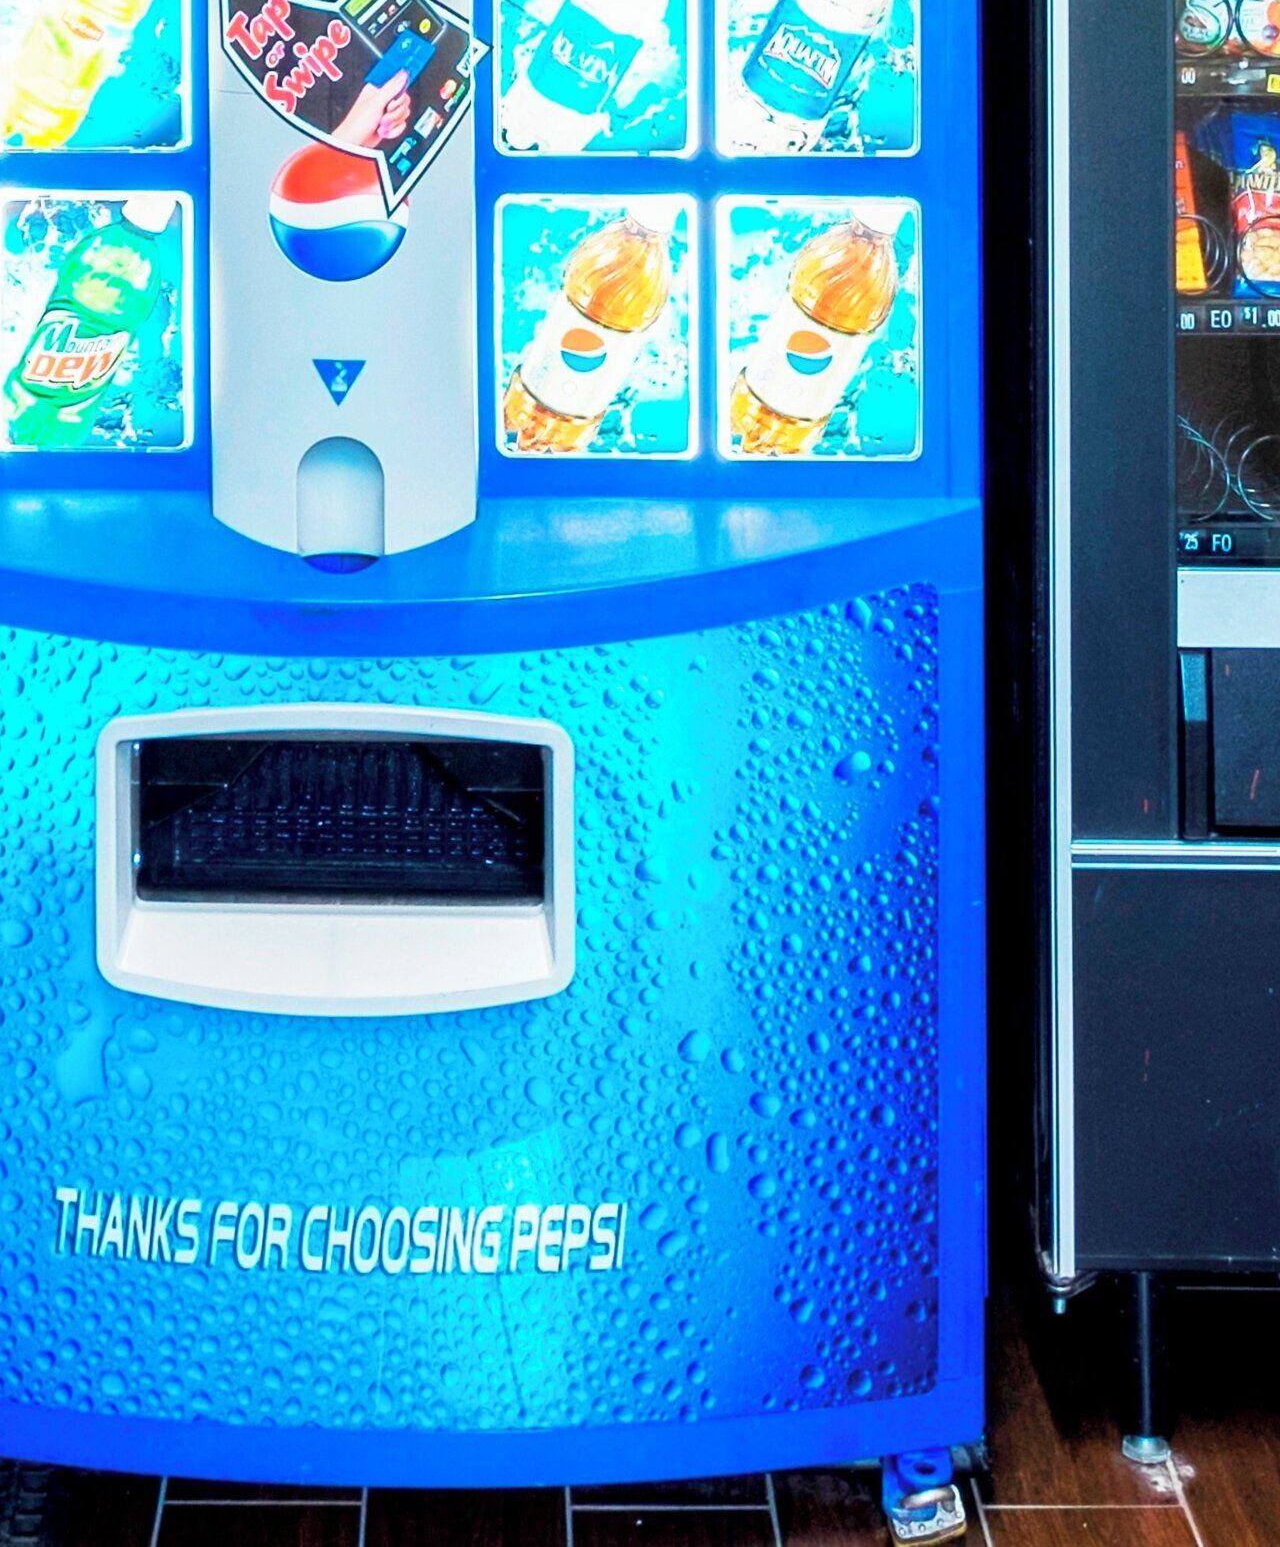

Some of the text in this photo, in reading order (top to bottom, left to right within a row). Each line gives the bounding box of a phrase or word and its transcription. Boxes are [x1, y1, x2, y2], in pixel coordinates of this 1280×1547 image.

[263, 19, 352, 114] Swipe
[1210, 310, 1232, 329] E0
[1211, 534, 1232, 553] F0
[55, 1185, 627, 1275] THANKS FOR CHOOSING PEPSI
